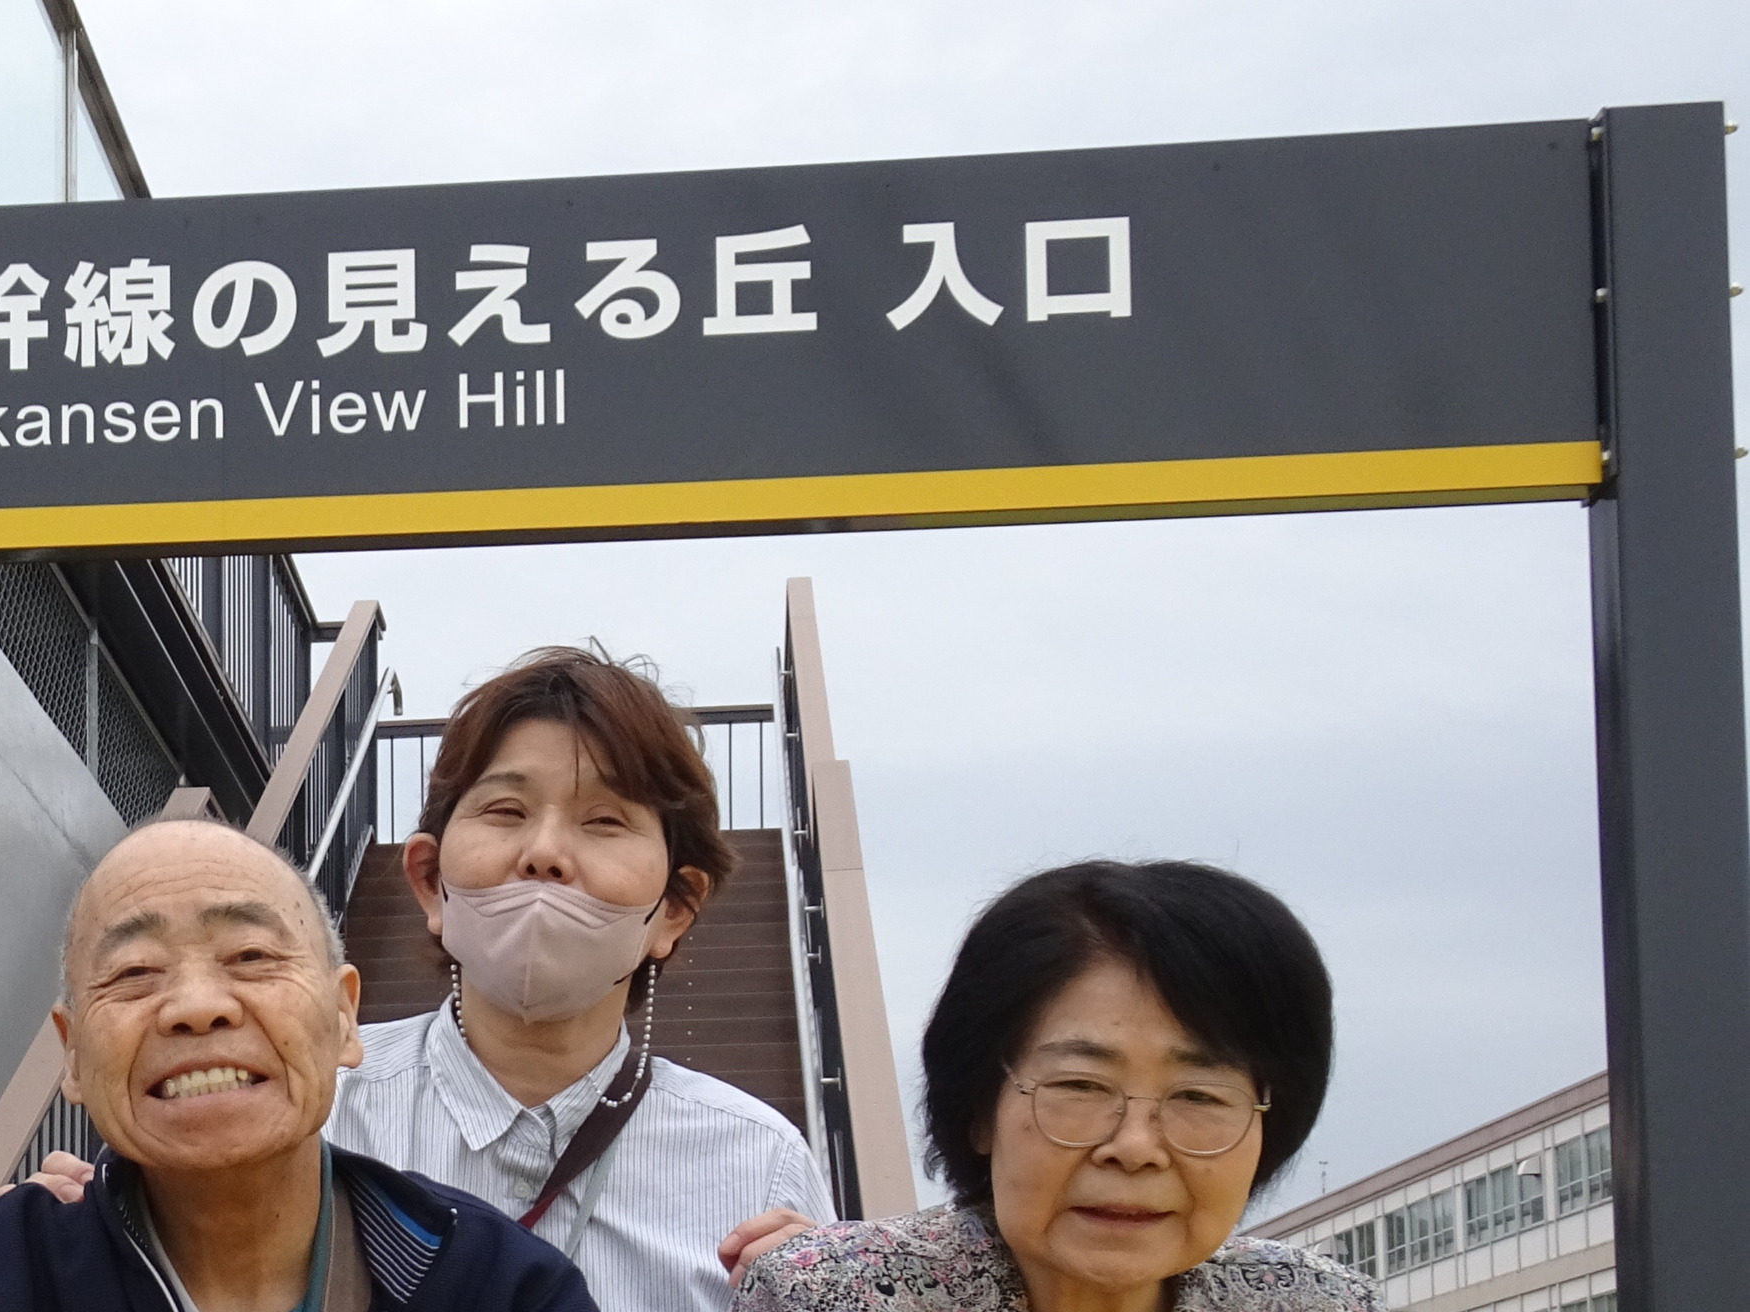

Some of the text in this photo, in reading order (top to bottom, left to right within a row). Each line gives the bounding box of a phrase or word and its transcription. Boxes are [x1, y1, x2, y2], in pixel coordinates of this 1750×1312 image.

[885, 216, 1132, 331] 入口
[254, 379, 427, 437] View
[458, 368, 565, 429] Hill
